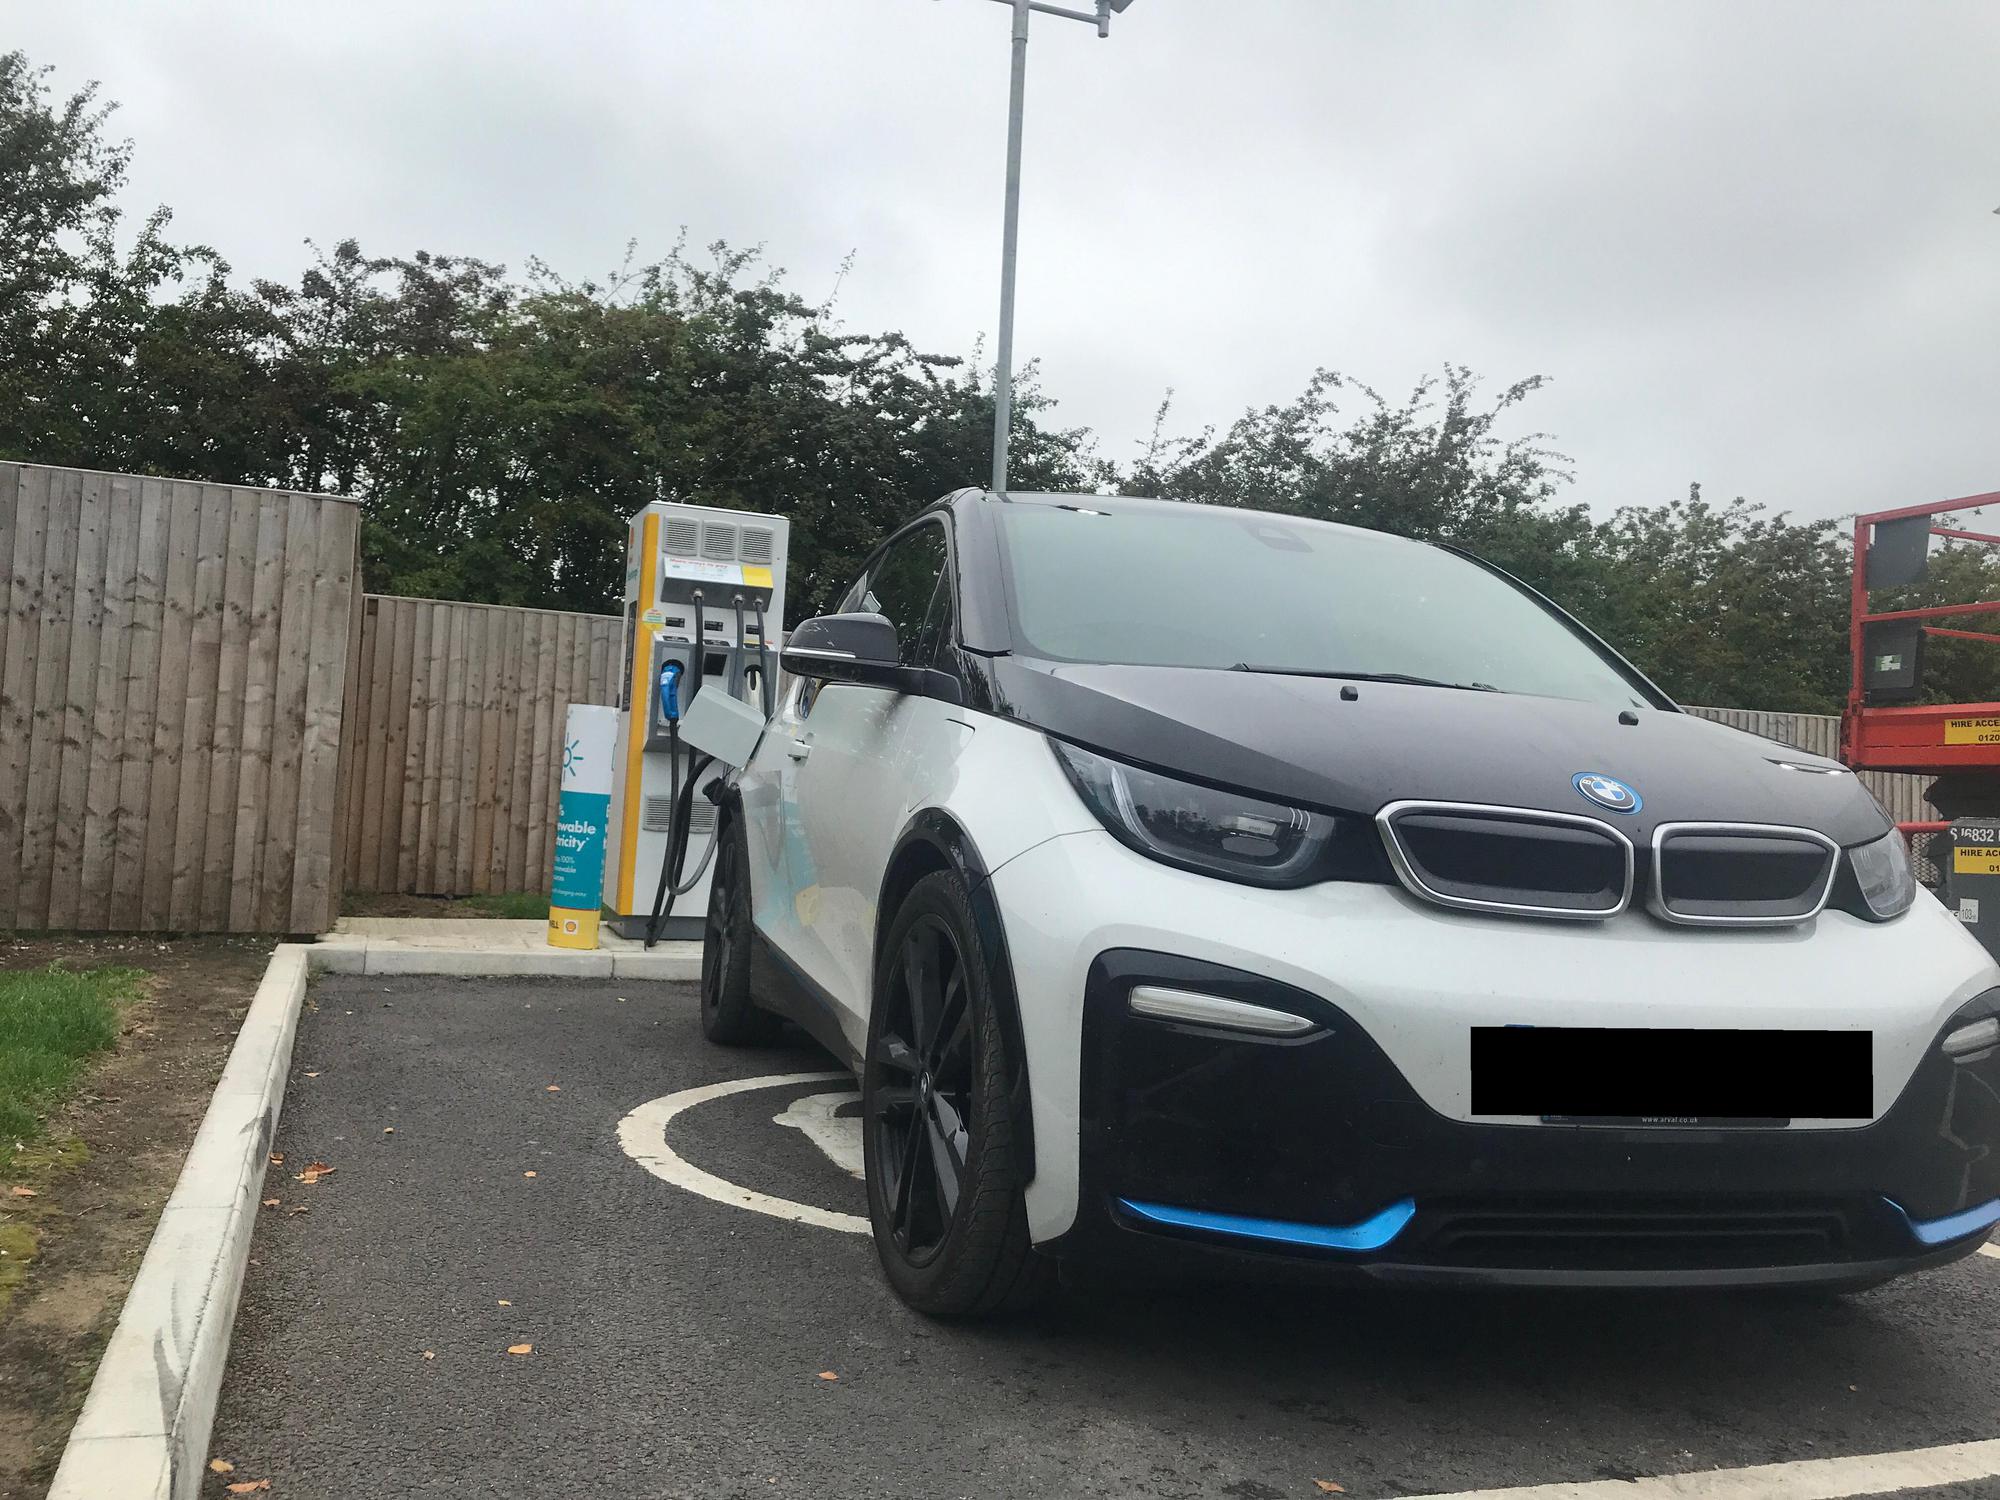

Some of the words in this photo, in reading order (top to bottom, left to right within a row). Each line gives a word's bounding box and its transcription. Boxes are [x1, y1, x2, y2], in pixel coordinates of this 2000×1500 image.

[1951, 720, 1973, 728] HIRE
[1978, 734, 2000, 742] 0120
[1960, 849, 1983, 857] HIRE
[1985, 849, 2000, 857] AC
